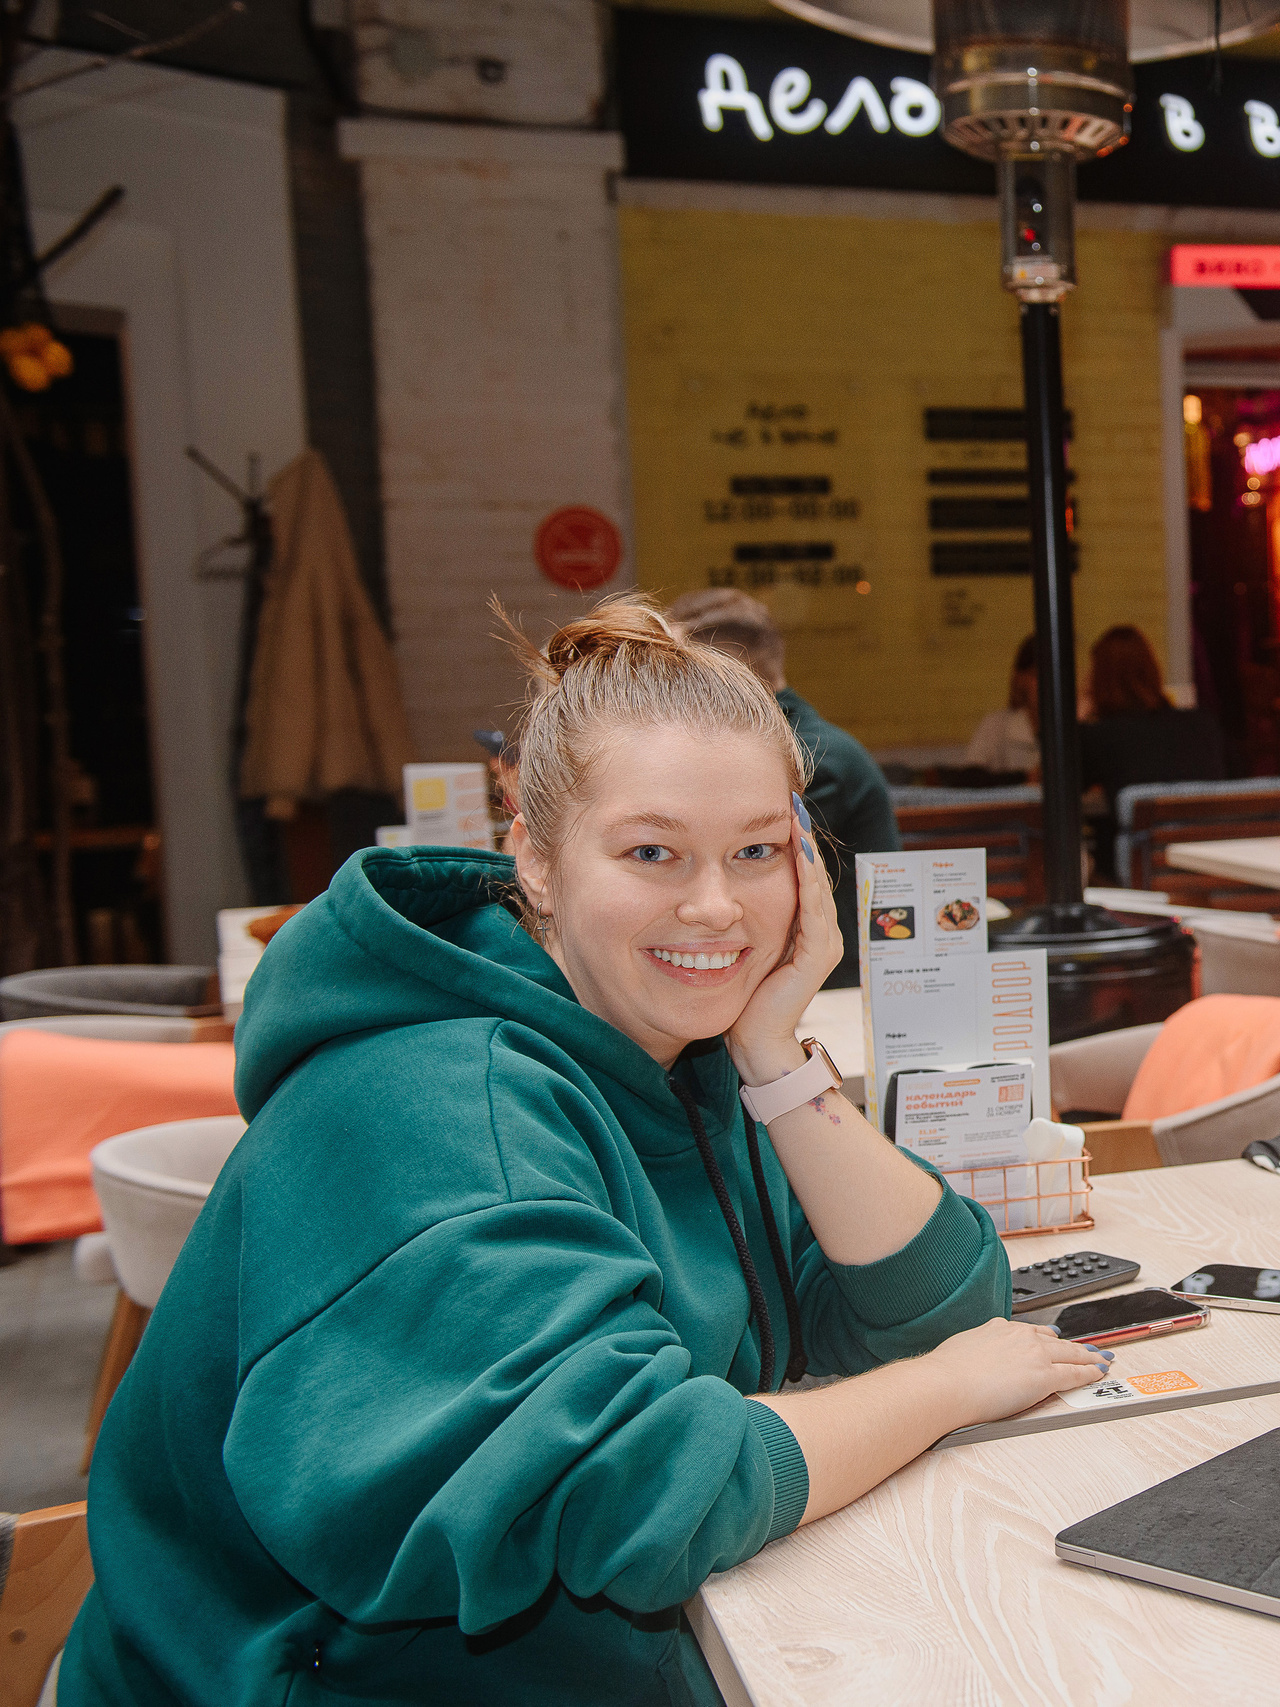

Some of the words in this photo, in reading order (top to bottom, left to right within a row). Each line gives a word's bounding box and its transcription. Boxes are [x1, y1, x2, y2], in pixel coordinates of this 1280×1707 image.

[883, 980, 922, 997] 20%
[991, 960, 1034, 1061] РОДВОР
[905, 1090, 977, 1102] календарь
[905, 1099, 964, 1111] событий
